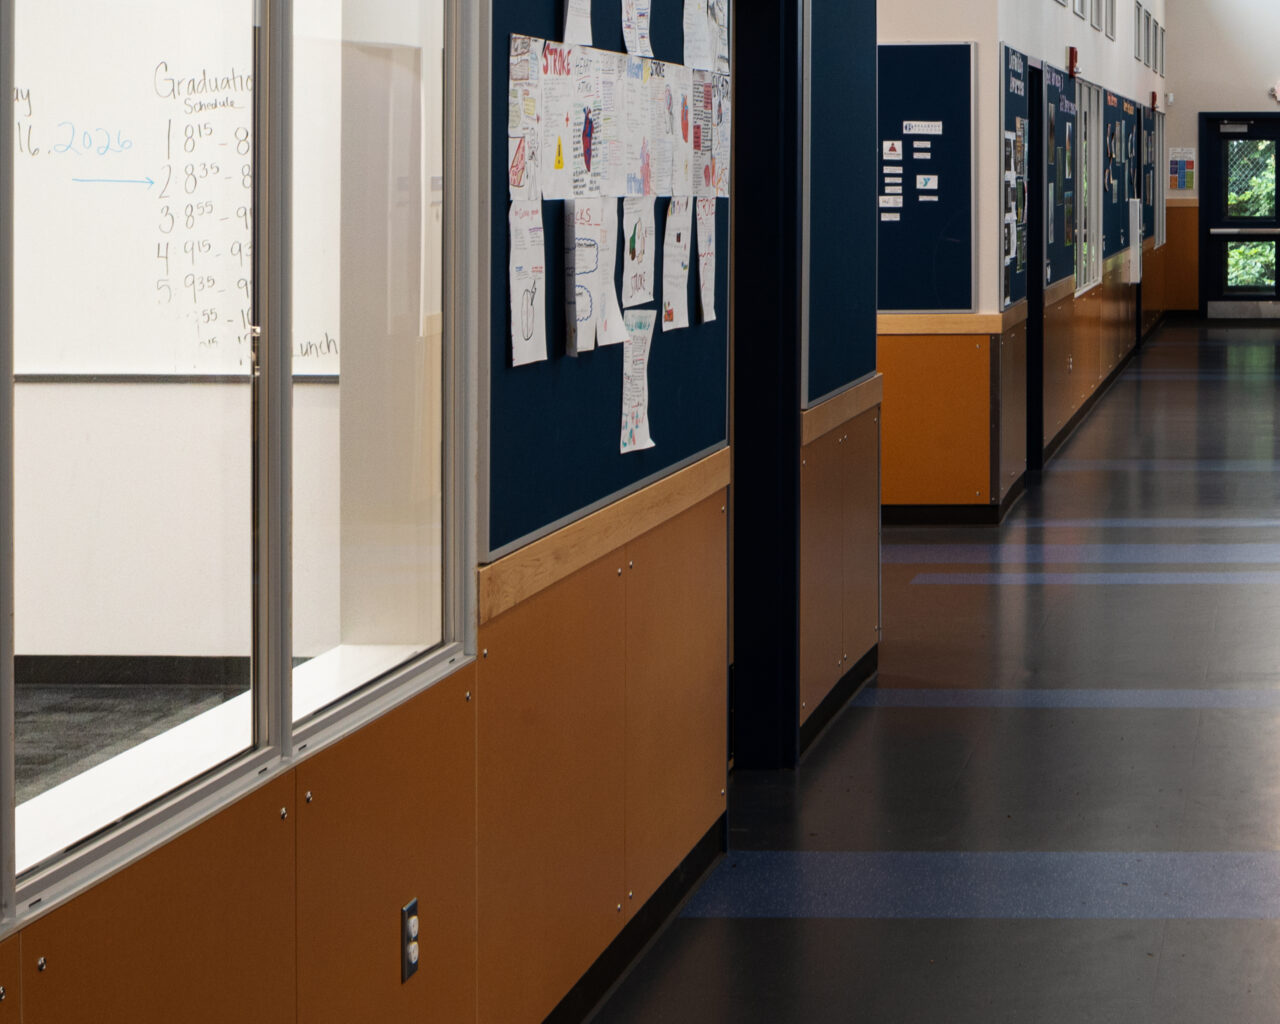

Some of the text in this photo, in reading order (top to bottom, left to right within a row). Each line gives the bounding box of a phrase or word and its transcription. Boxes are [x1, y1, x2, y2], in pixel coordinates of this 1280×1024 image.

[542, 42, 572, 76] STROKE
[183, 96, 245, 115] Schedule
[53, 121, 133, 155] 2026
[158, 164, 171, 199] 2
[159, 205, 174, 234] 3
[236, 206, 252, 230] 9
[157, 242, 169, 276] 4
[157, 278, 171, 304] 5
[293, 331, 339, 358] unch
